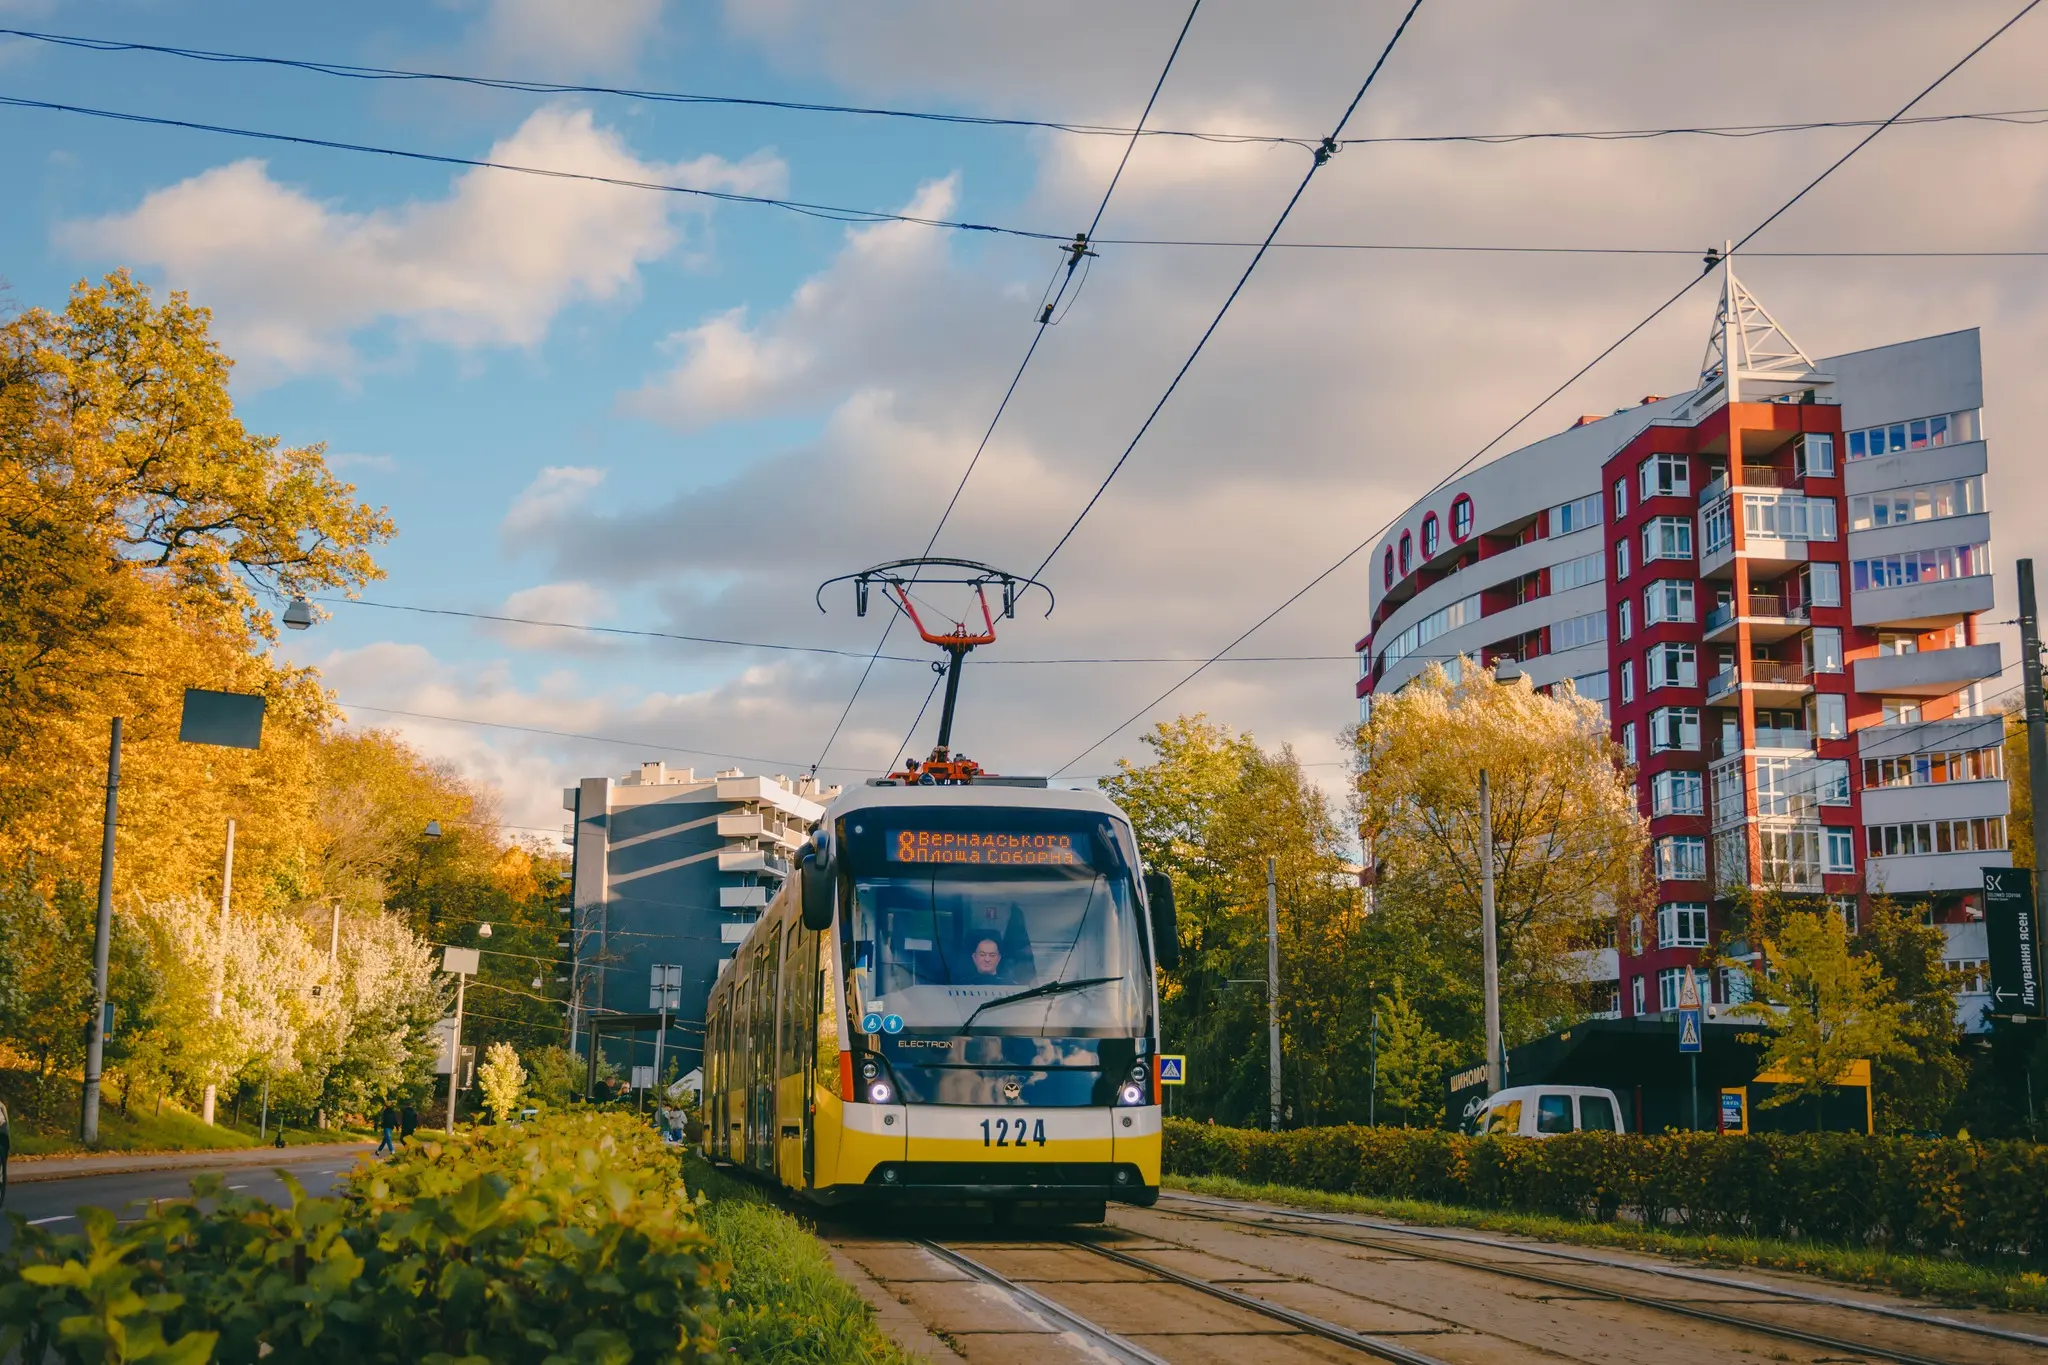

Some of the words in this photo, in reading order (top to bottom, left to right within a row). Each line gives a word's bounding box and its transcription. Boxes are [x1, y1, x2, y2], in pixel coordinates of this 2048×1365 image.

[899, 831, 915, 862] 8
[918, 831, 1071, 848] Вернадського
[917, 848, 981, 864] Площа
[987, 849, 1073, 864] Соборна
[2018, 912, 2029, 940] ясен
[2020, 943, 2036, 1006] Лікування
[898, 1040, 954, 1049] ELECTRON
[980, 1118, 1046, 1147] 1224
